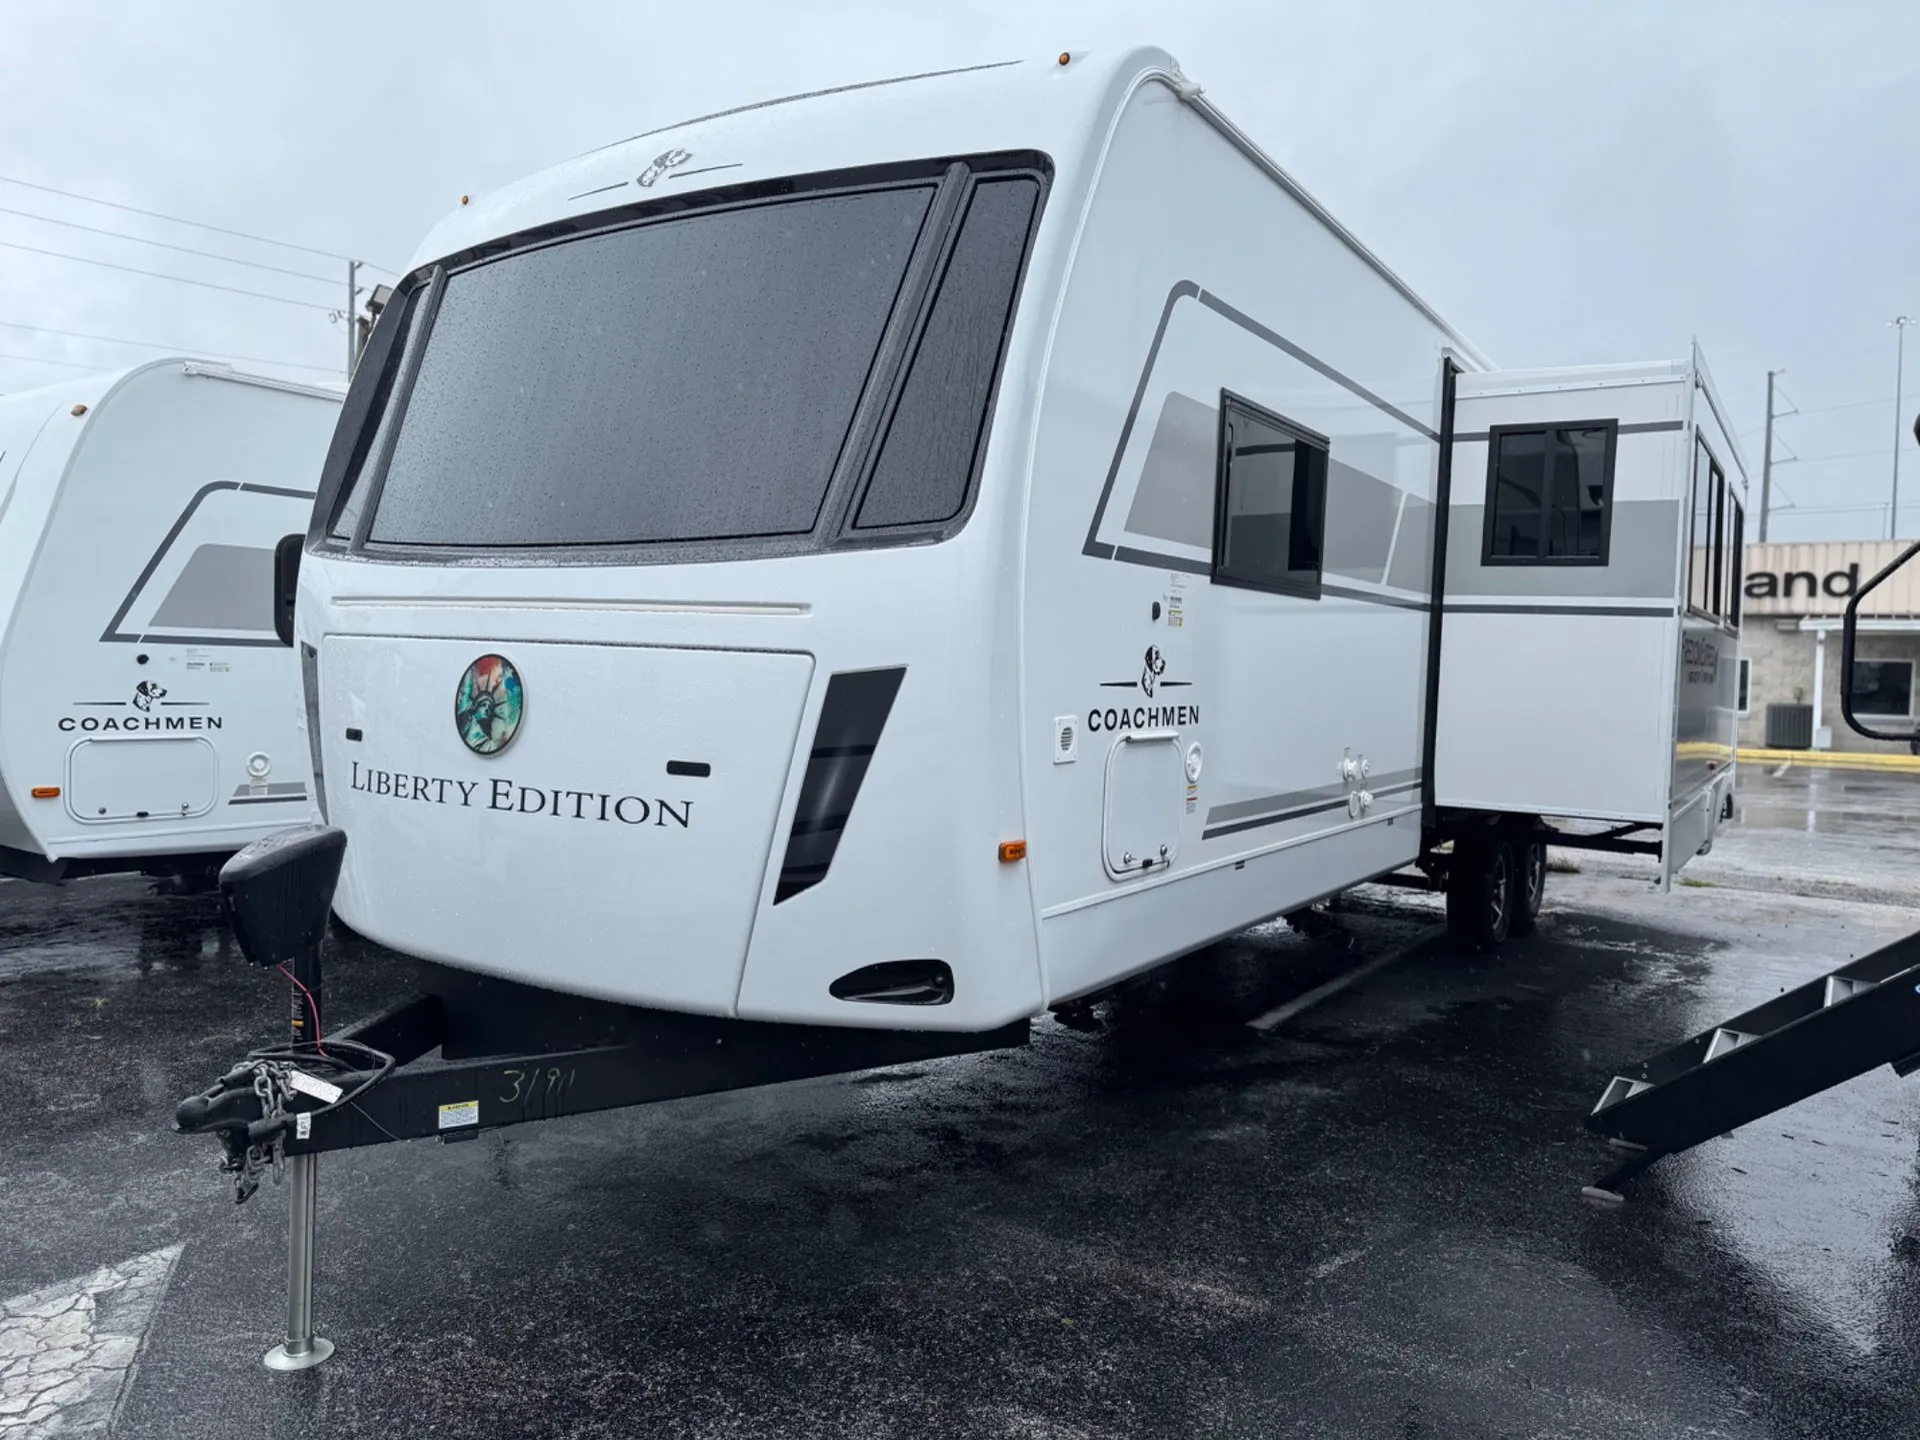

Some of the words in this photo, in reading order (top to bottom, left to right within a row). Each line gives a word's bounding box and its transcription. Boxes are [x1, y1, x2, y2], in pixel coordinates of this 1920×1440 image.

[57, 716, 223, 732] COACHMEN
[1087, 705, 1200, 732] COACHMEN
[350, 760, 479, 807] LIBERTY
[487, 778, 695, 829] EDITION
